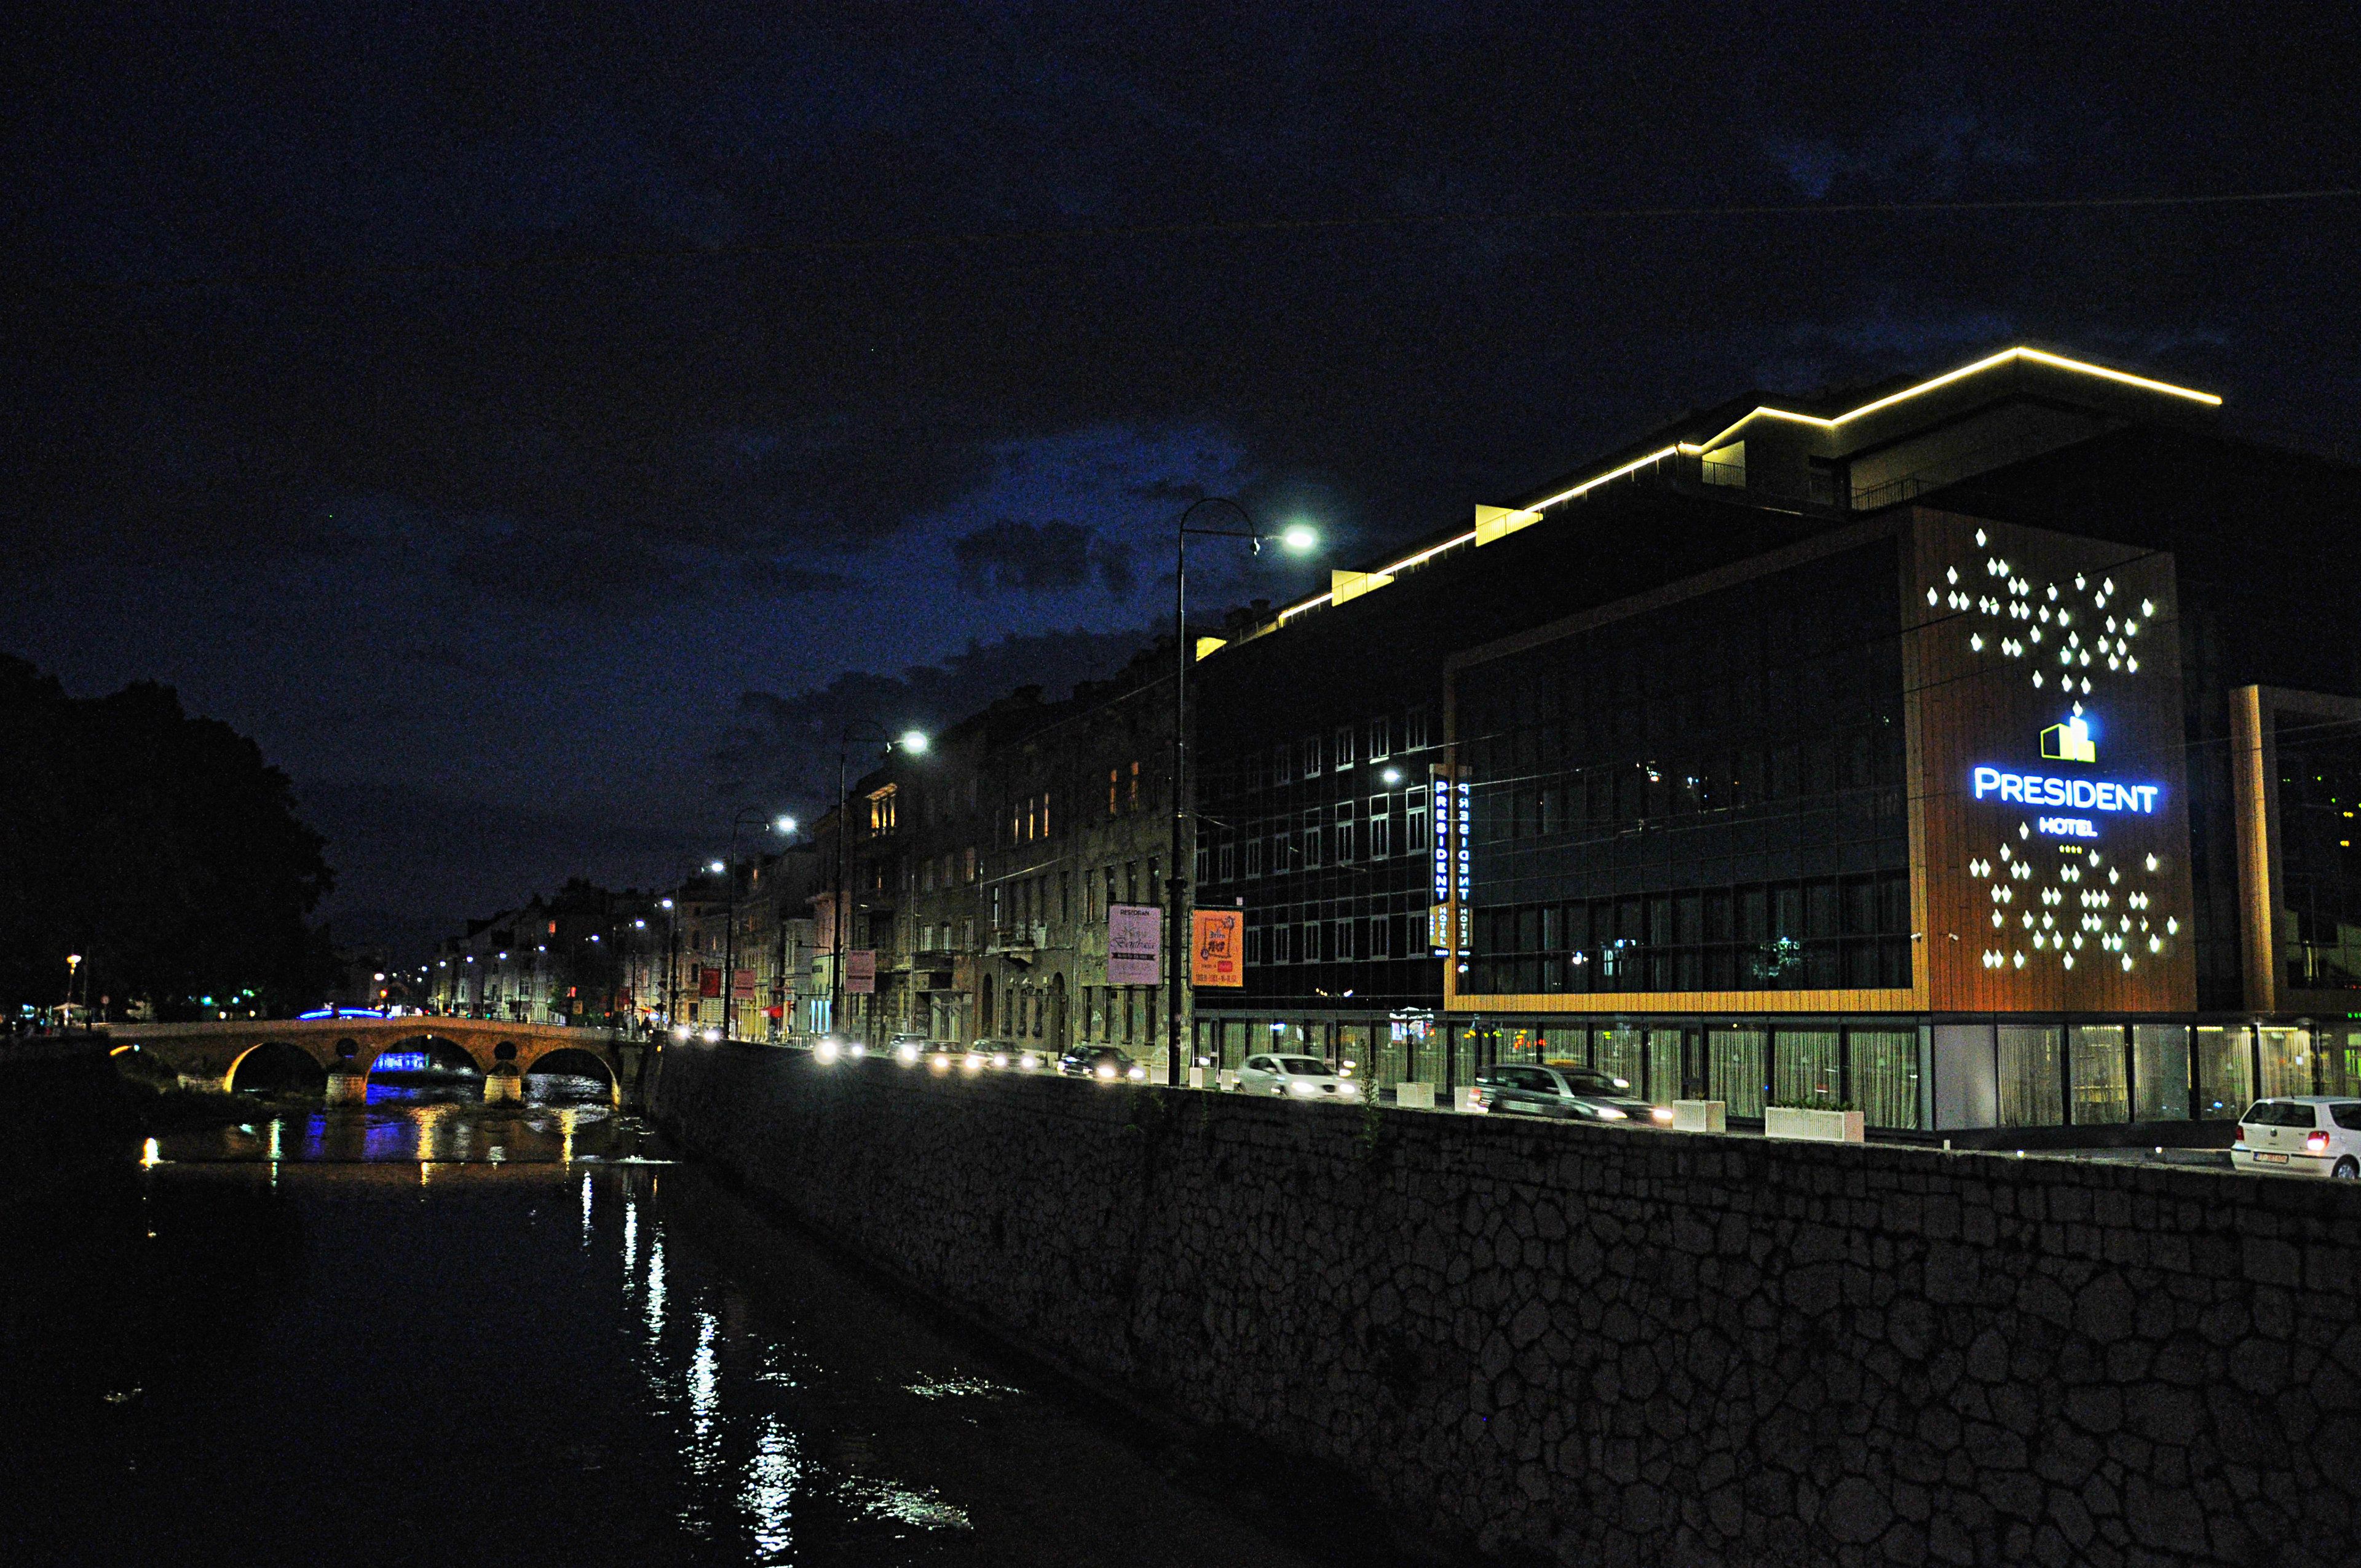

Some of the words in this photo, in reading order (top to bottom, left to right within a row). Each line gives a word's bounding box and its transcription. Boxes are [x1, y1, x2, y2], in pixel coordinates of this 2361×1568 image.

[1974, 767, 2158, 814] PRESIDENT
[1436, 781, 1448, 900] PRESIDENT
[2039, 816, 2098, 837] HOTEL
[1439, 906, 1447, 945] HOTEL
